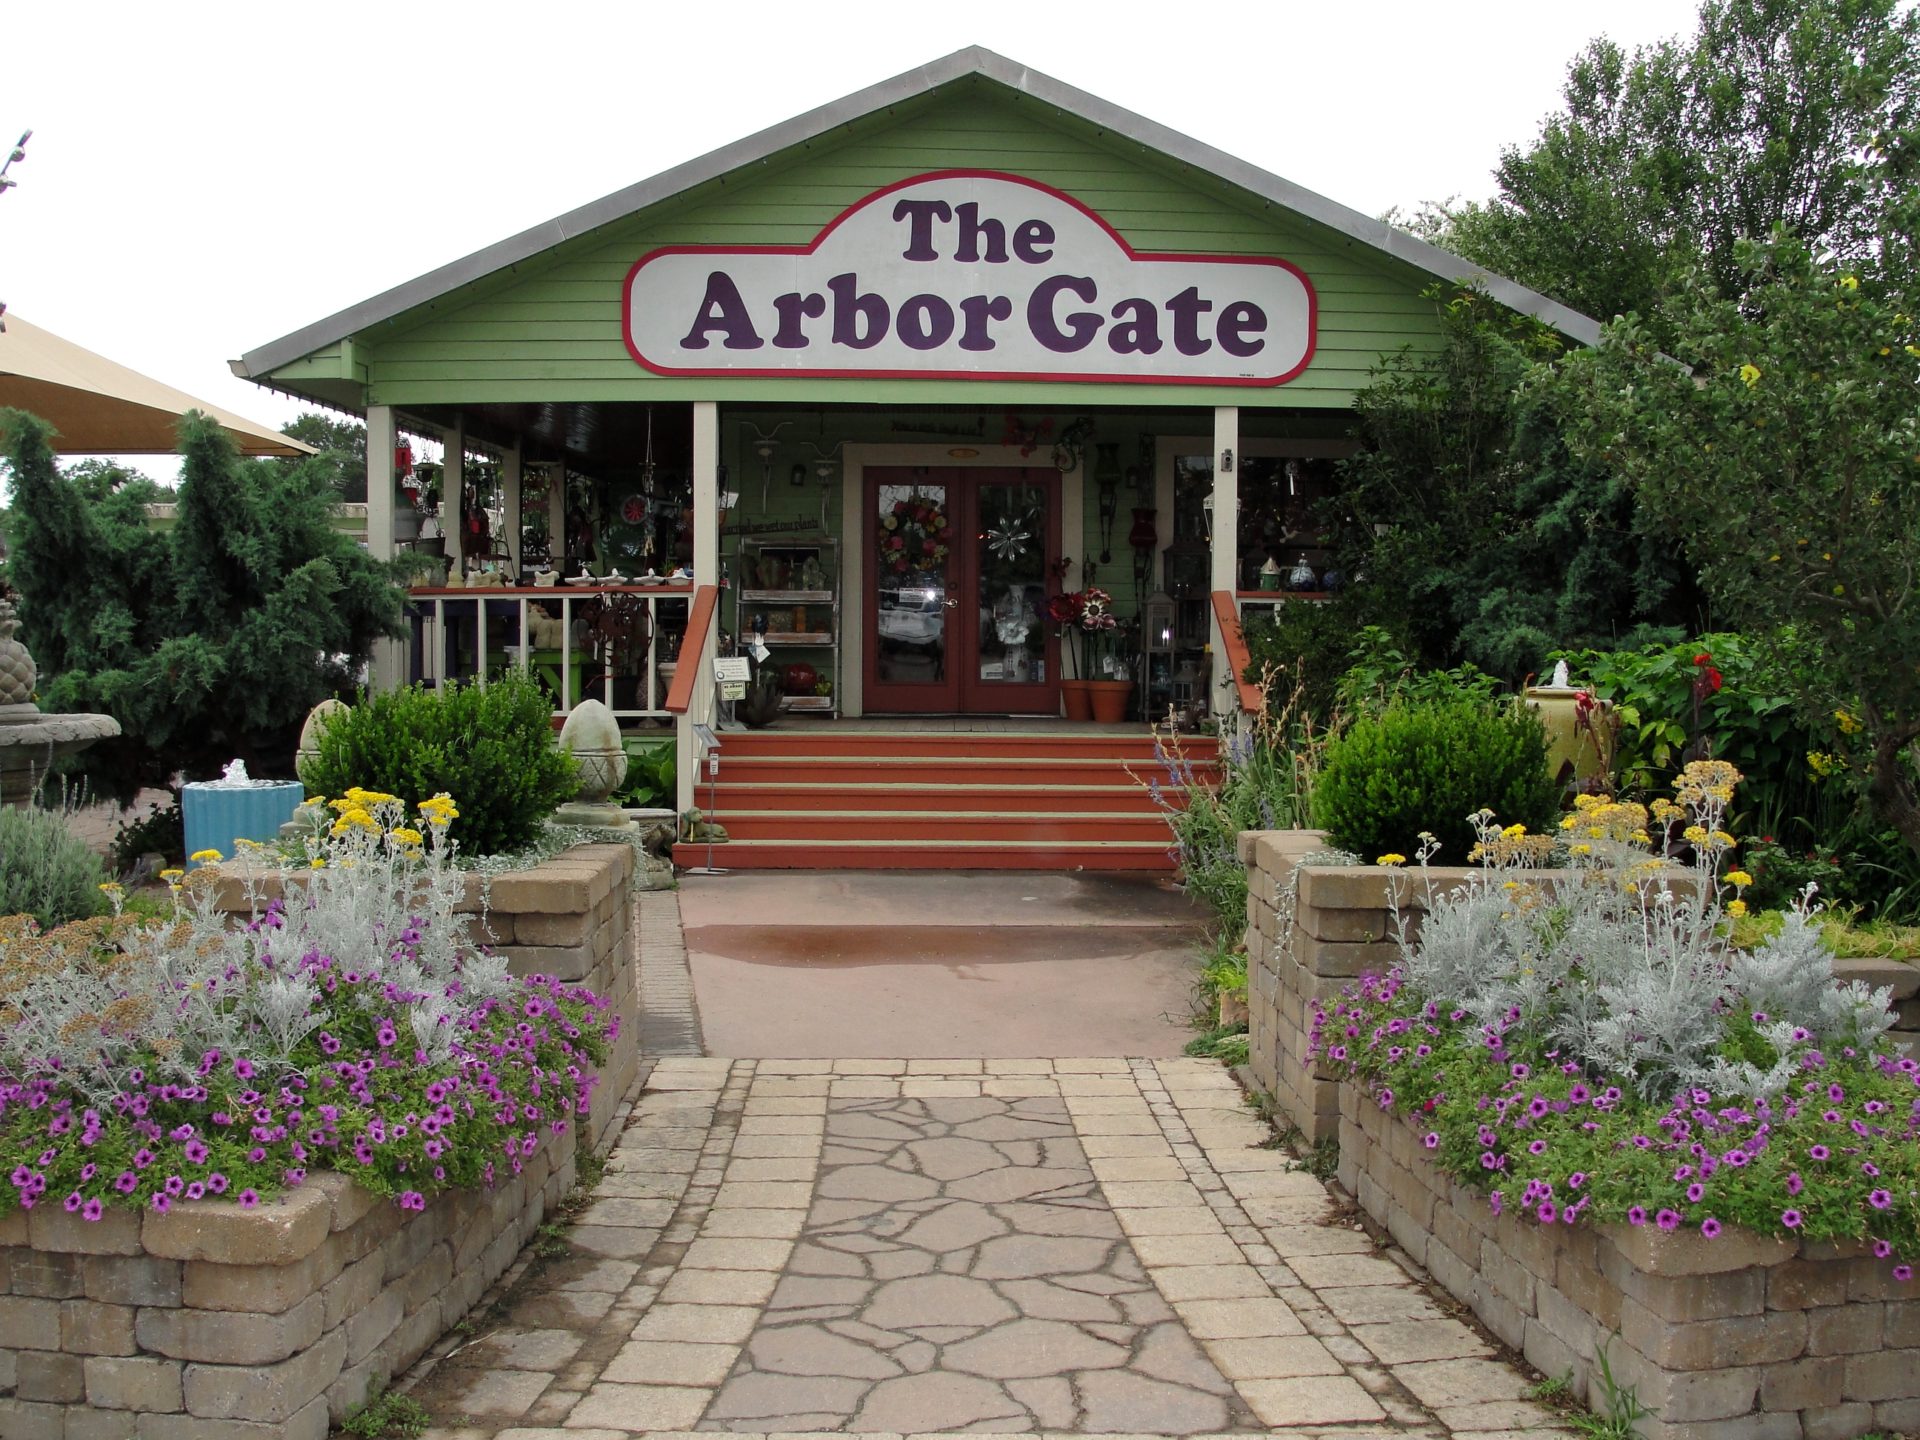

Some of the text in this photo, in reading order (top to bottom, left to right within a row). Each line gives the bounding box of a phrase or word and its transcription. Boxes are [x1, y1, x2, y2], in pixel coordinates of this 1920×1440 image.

[892, 199, 1056, 264] The
[679, 270, 1268, 357] Arbor Gate
